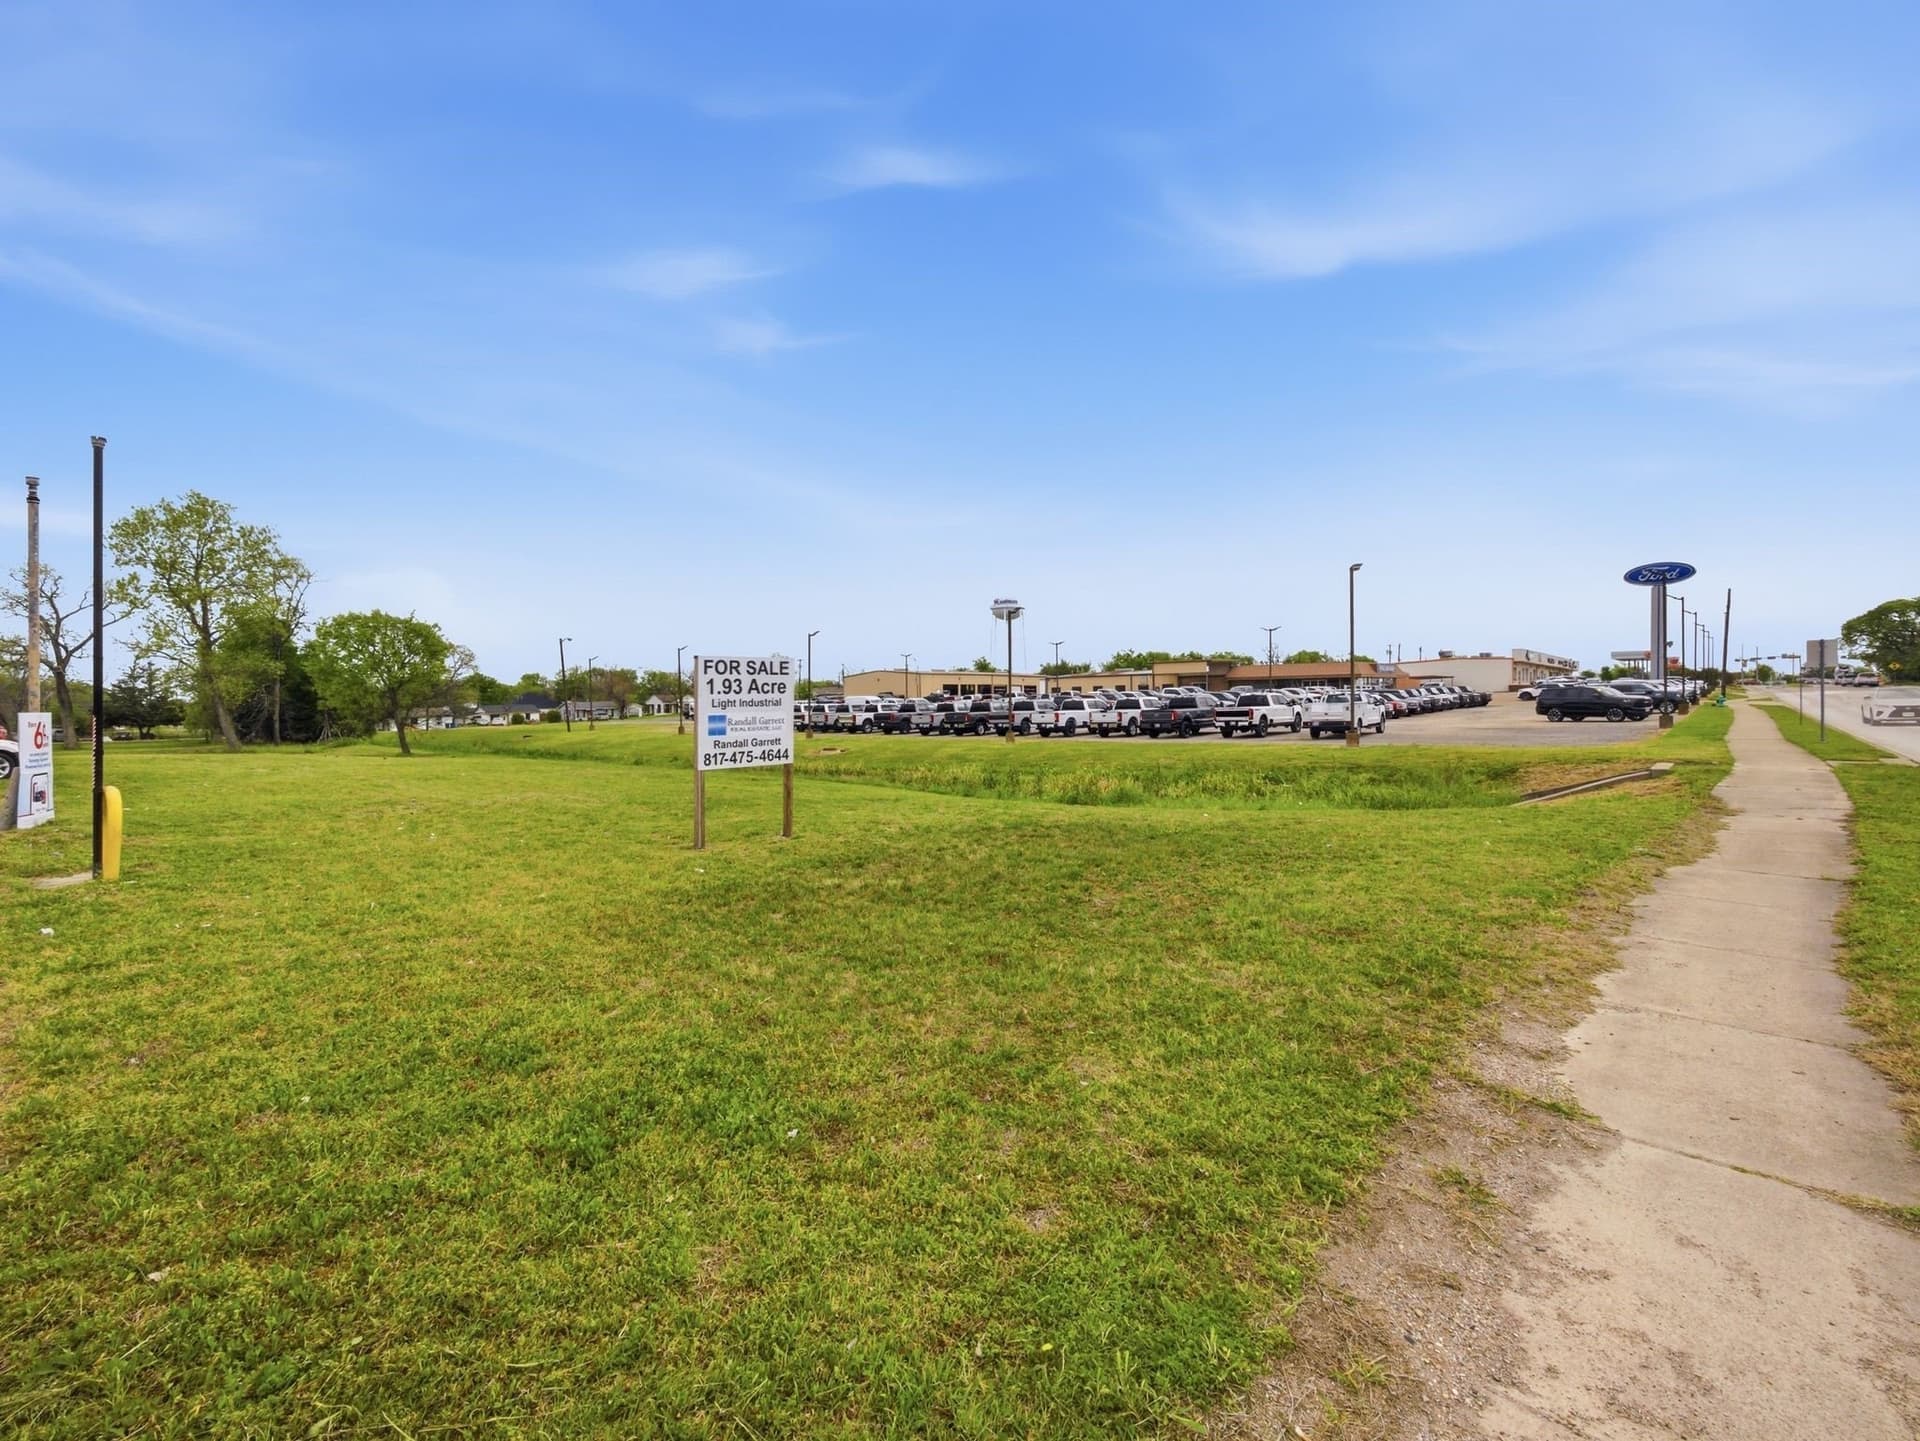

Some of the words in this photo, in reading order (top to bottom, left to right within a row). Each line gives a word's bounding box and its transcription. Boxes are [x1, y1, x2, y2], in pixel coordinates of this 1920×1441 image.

[1638, 566, 1680, 581] Ford
[703, 659, 742, 675] FOR
[746, 660, 790, 676] SALE
[706, 678, 743, 695] 1.93
[747, 678, 787, 695] Acre
[711, 698, 737, 710] Light
[739, 697, 782, 708] Industrial
[727, 716, 758, 726] Randall
[713, 738, 749, 749] Randall
[750, 737, 782, 747] Garrett
[703, 747, 790, 767] 817-475-4644
